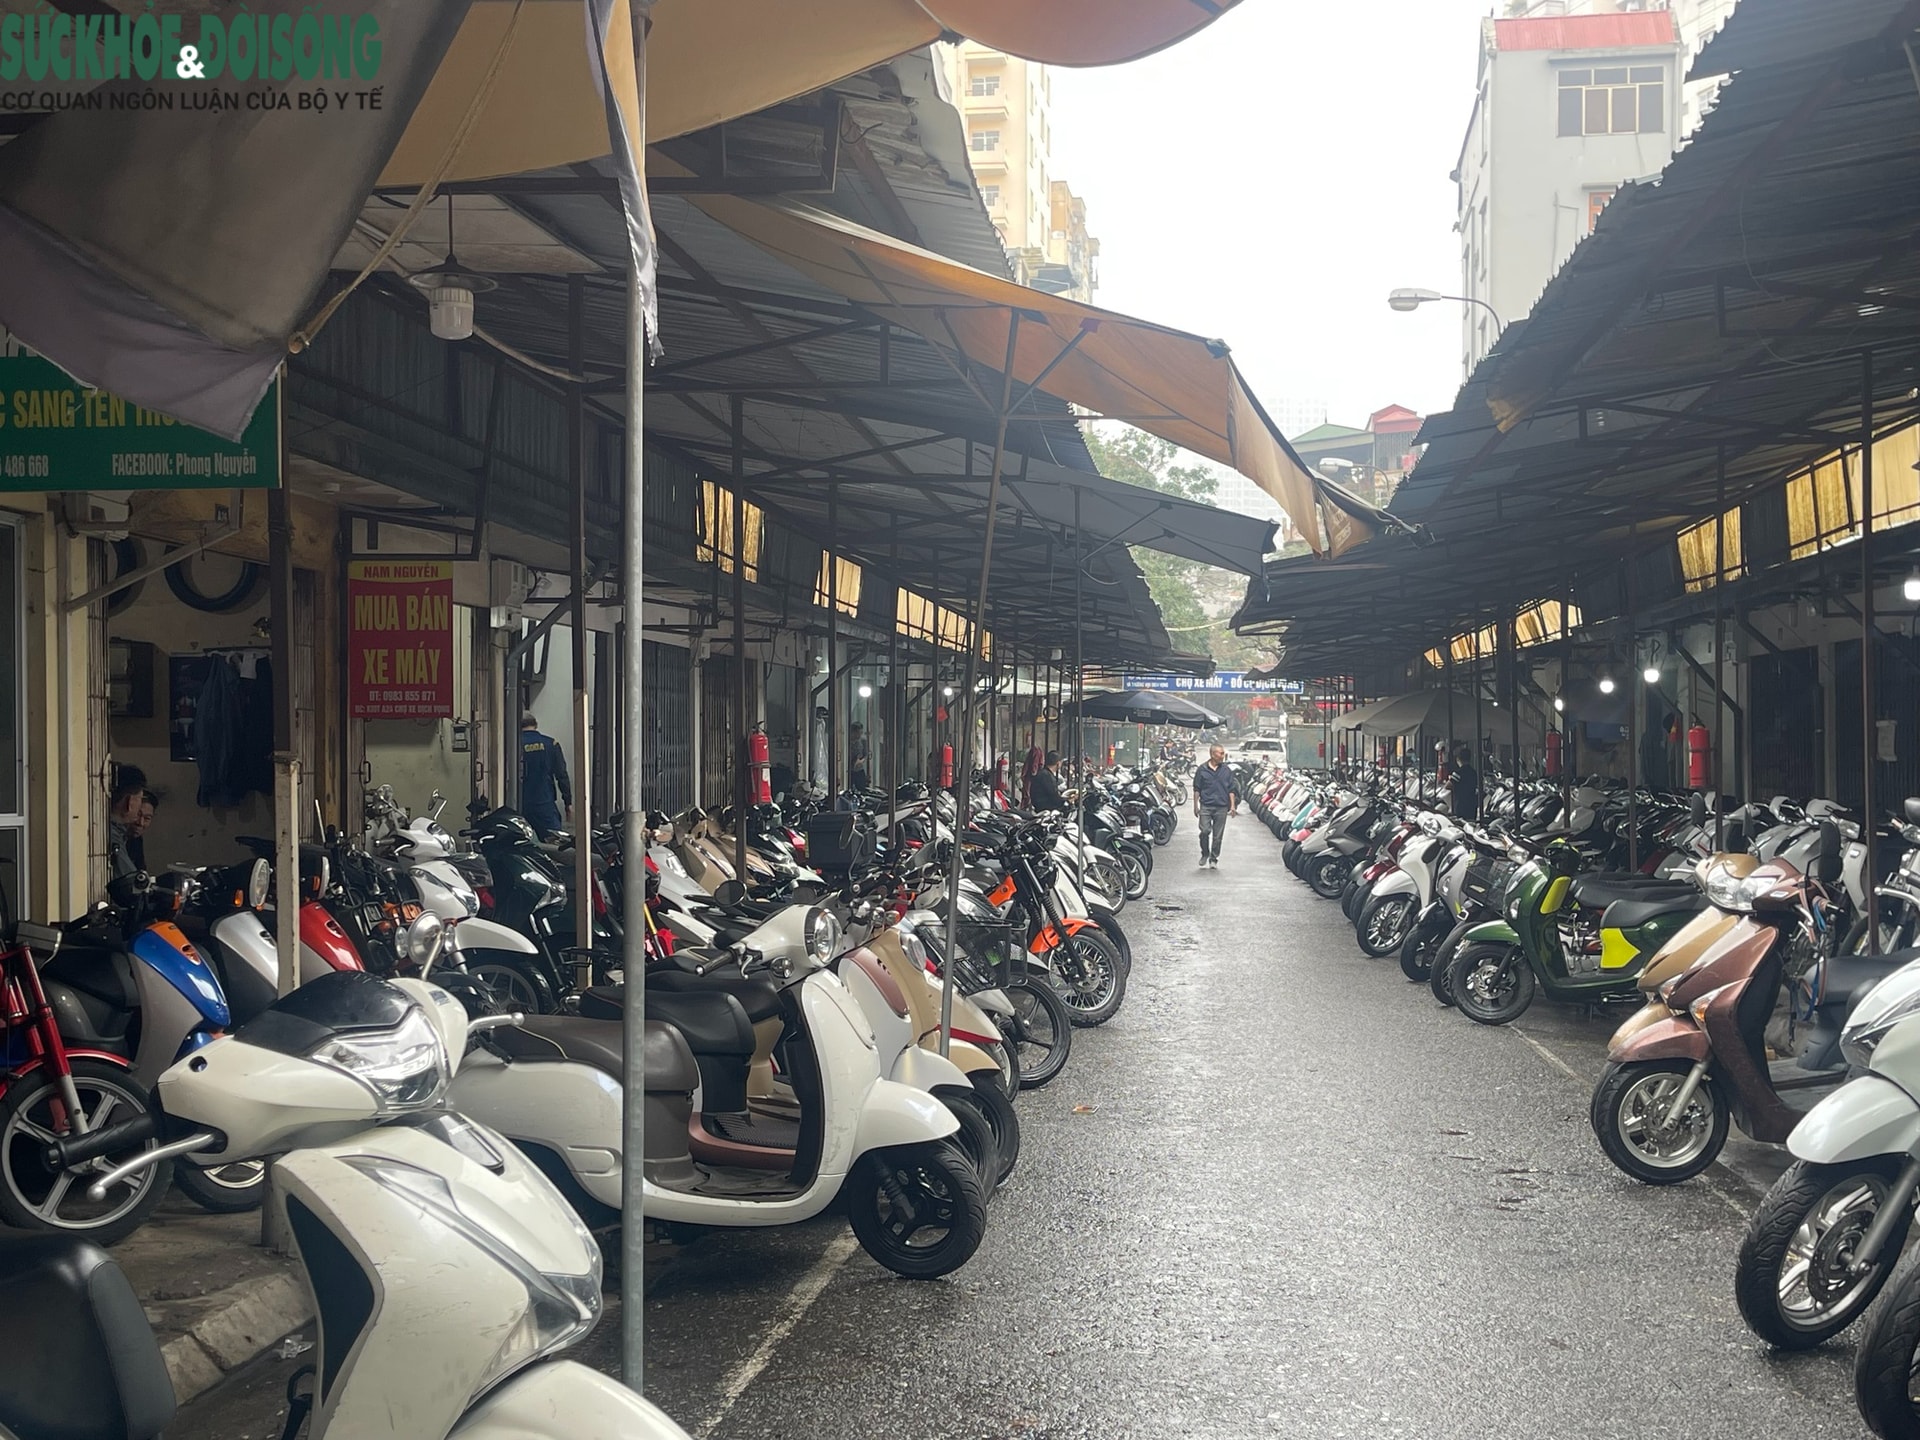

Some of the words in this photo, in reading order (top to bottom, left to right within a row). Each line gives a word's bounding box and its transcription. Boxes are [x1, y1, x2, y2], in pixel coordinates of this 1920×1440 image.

[13, 390, 75, 428] SANG
[5, 455, 25, 477] 486
[28, 455, 49, 477] 668
[112, 453, 173, 476] FACEBOOK:
[176, 453, 212, 477] Phong
[214, 448, 257, 478] Nguyễn
[364, 566, 390, 578] NAM
[355, 595, 400, 631] MUA
[406, 587, 449, 631] BÁN
[363, 648, 389, 685] XE
[396, 641, 441, 685] MÁY
[1194, 678, 1205, 688] XE
